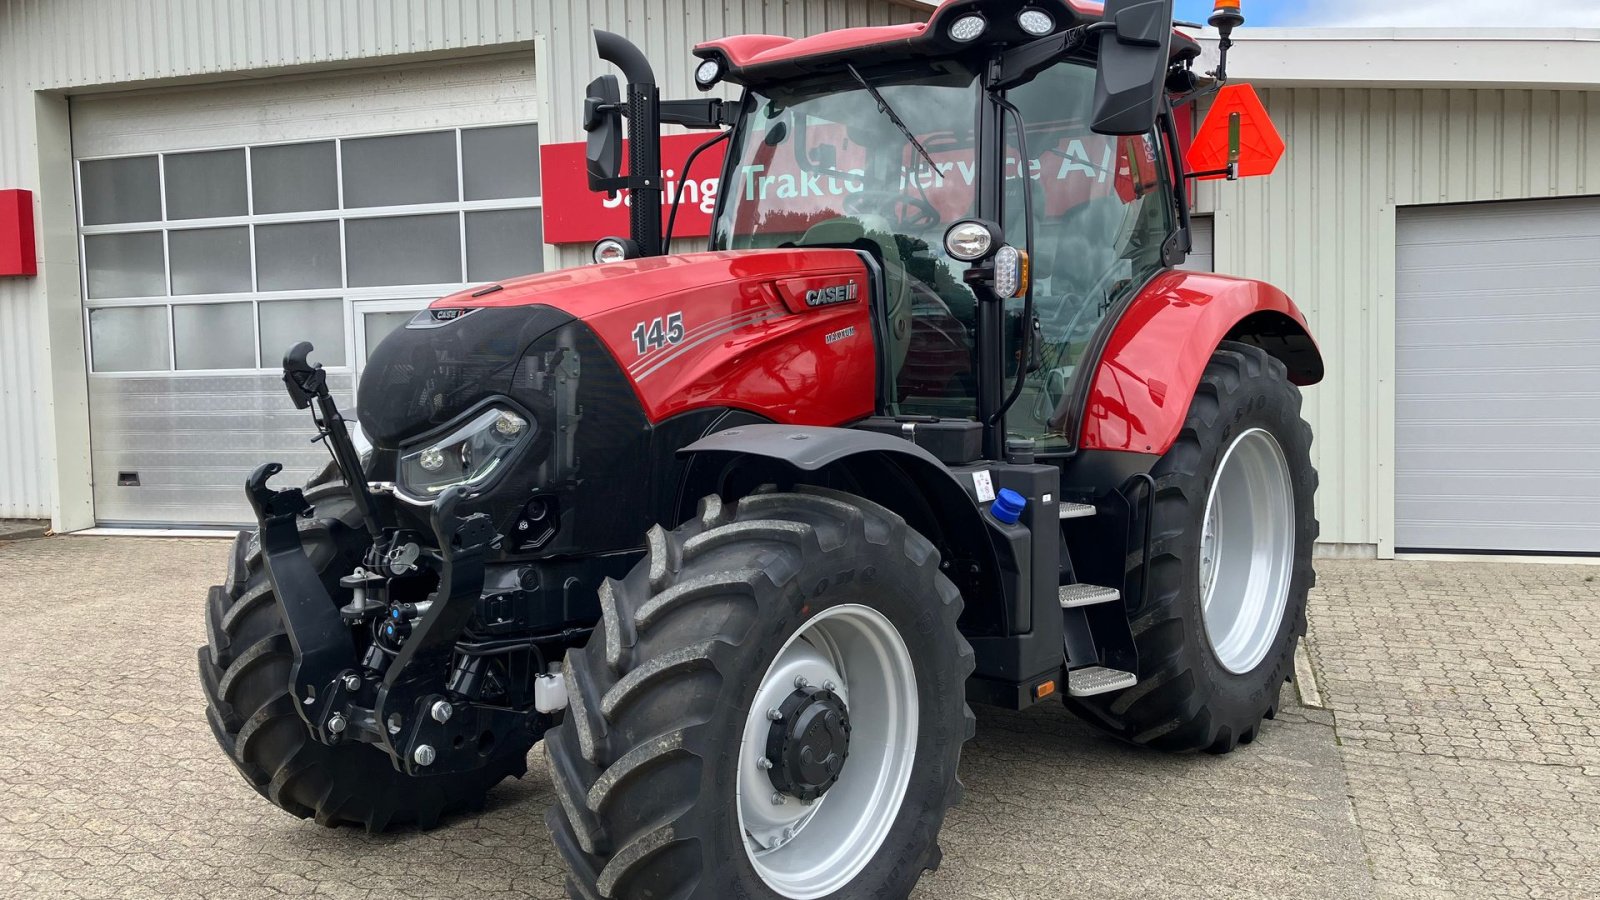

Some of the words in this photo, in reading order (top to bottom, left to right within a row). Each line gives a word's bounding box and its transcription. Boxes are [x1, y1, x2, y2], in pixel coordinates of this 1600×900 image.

[805, 285, 846, 306] CASE
[437, 310, 457, 319] CASE
[631, 310, 685, 356] 145
